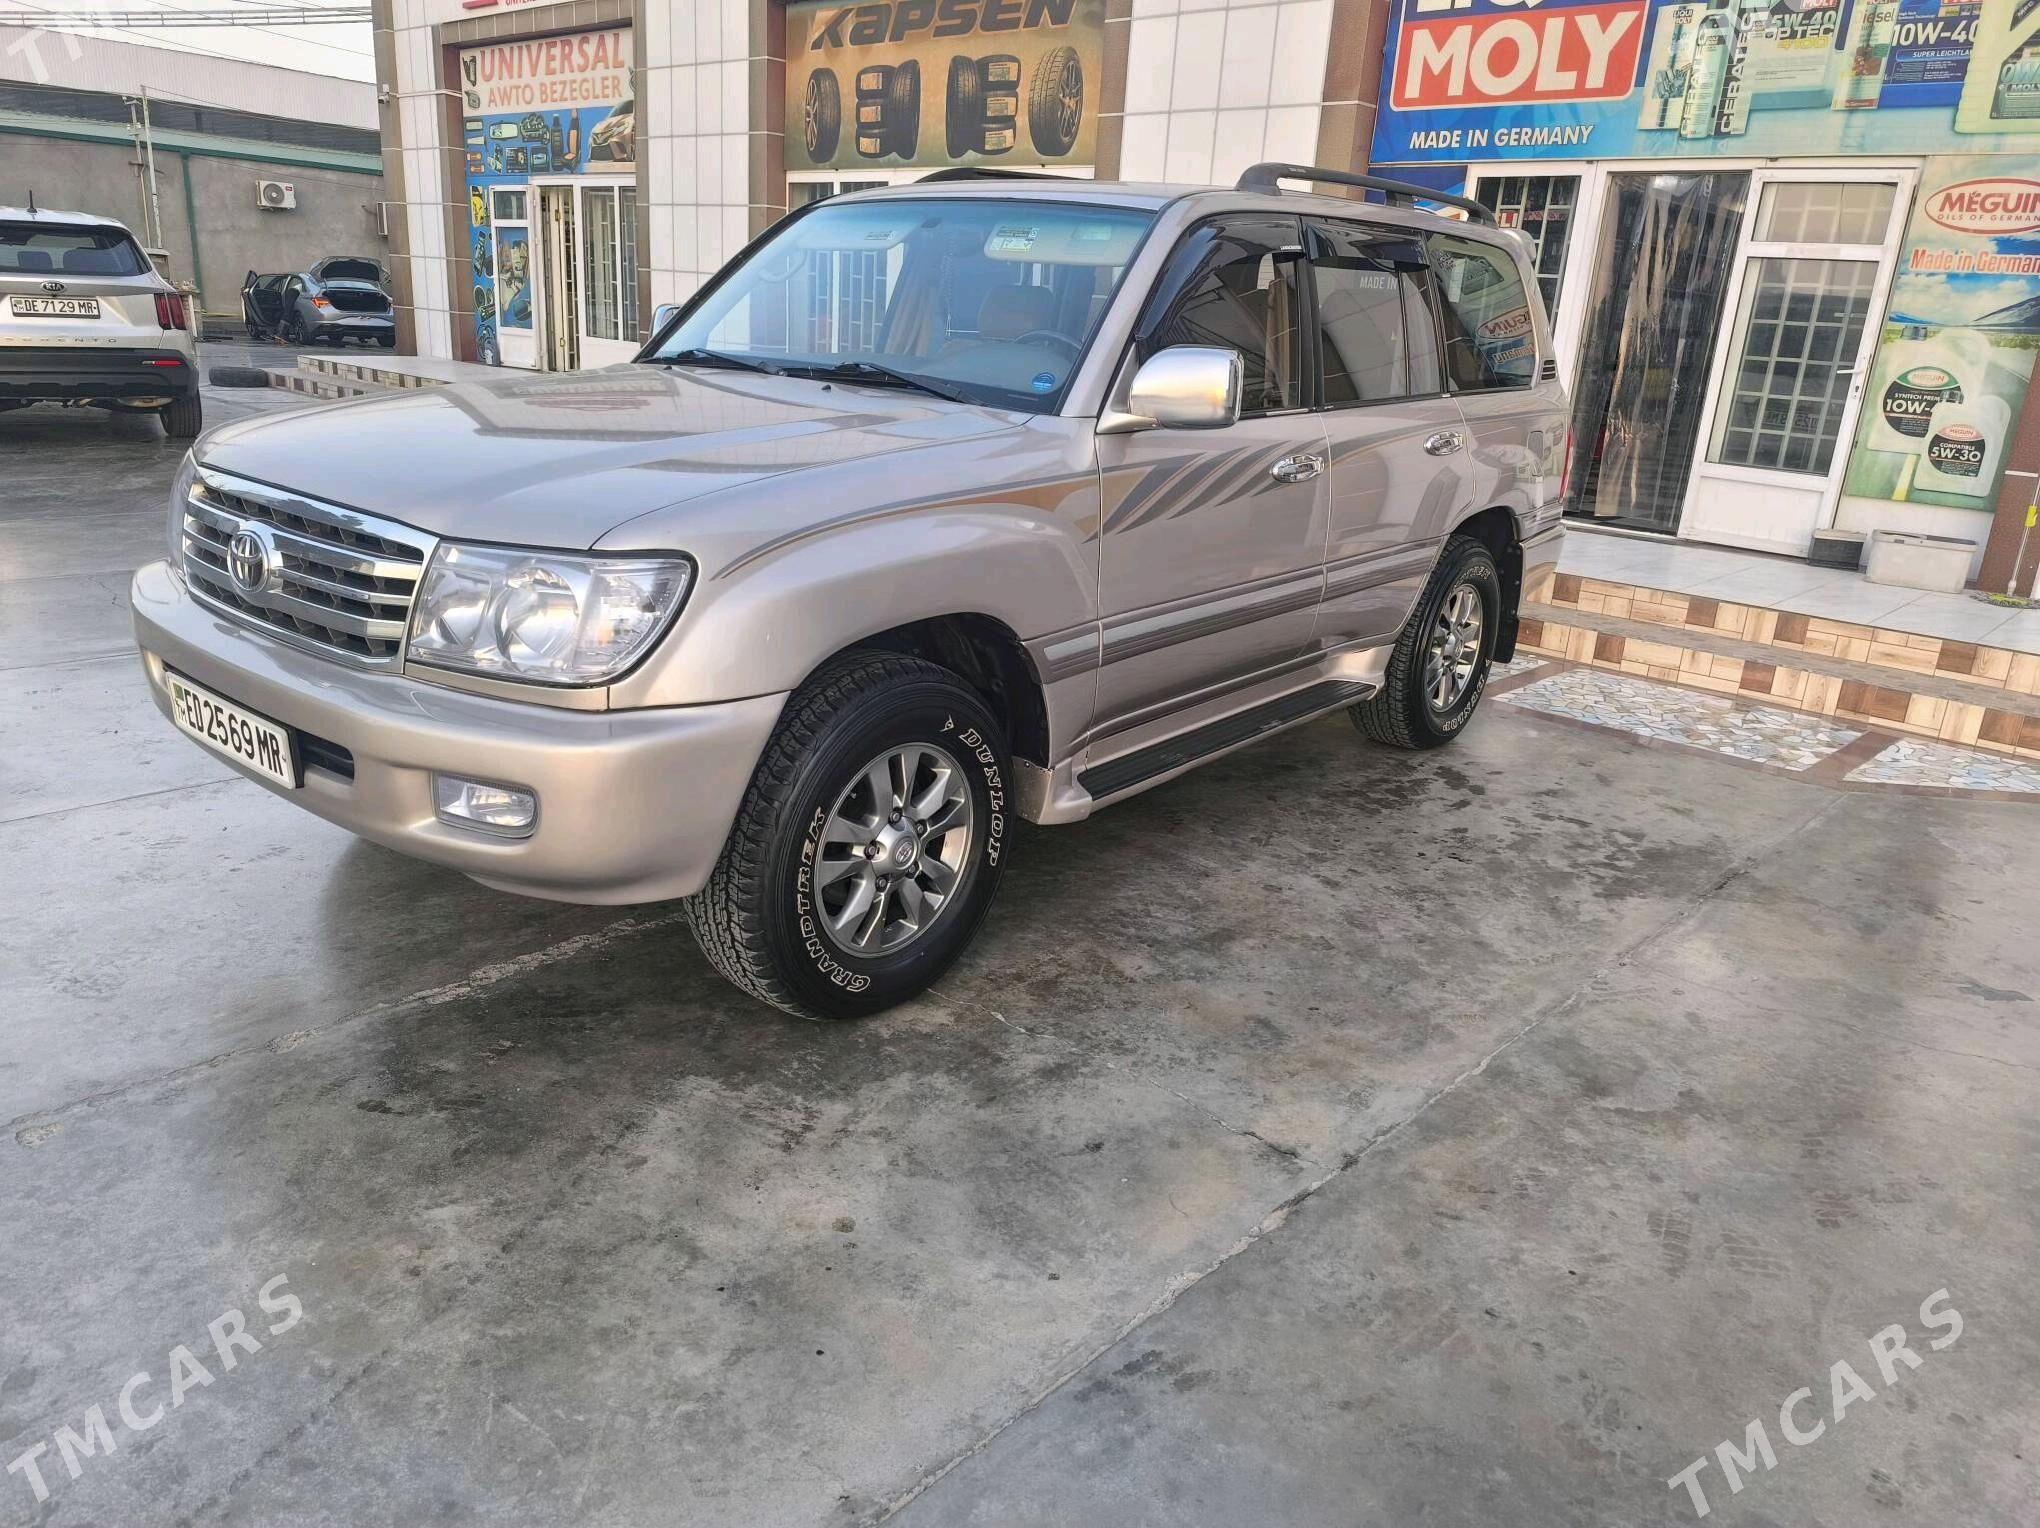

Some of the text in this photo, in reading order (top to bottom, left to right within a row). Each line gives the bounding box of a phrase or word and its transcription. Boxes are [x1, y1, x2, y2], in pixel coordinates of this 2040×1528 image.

[480, 32, 625, 82] UNIVERSAL
[1404, 11, 1639, 98] MOLY
[1936, 49, 1970, 58] LEICHTLA
[488, 76, 622, 108] AWTO BEZEGLER
[1409, 125, 1594, 149] MADE IN GERMANY
[1910, 248, 1955, 270] Made
[1956, 250, 1973, 271] in
[45, 282, 63, 291] KIA
[1359, 276, 1385, 289] MADE
[41, 300, 76, 313] 7129
[1895, 392, 1922, 400] SYNTECH
[1930, 446, 1981, 461] 5W-30
[958, 728, 1004, 867] DUNLOP
[797, 806, 871, 992] GRANDTREK
